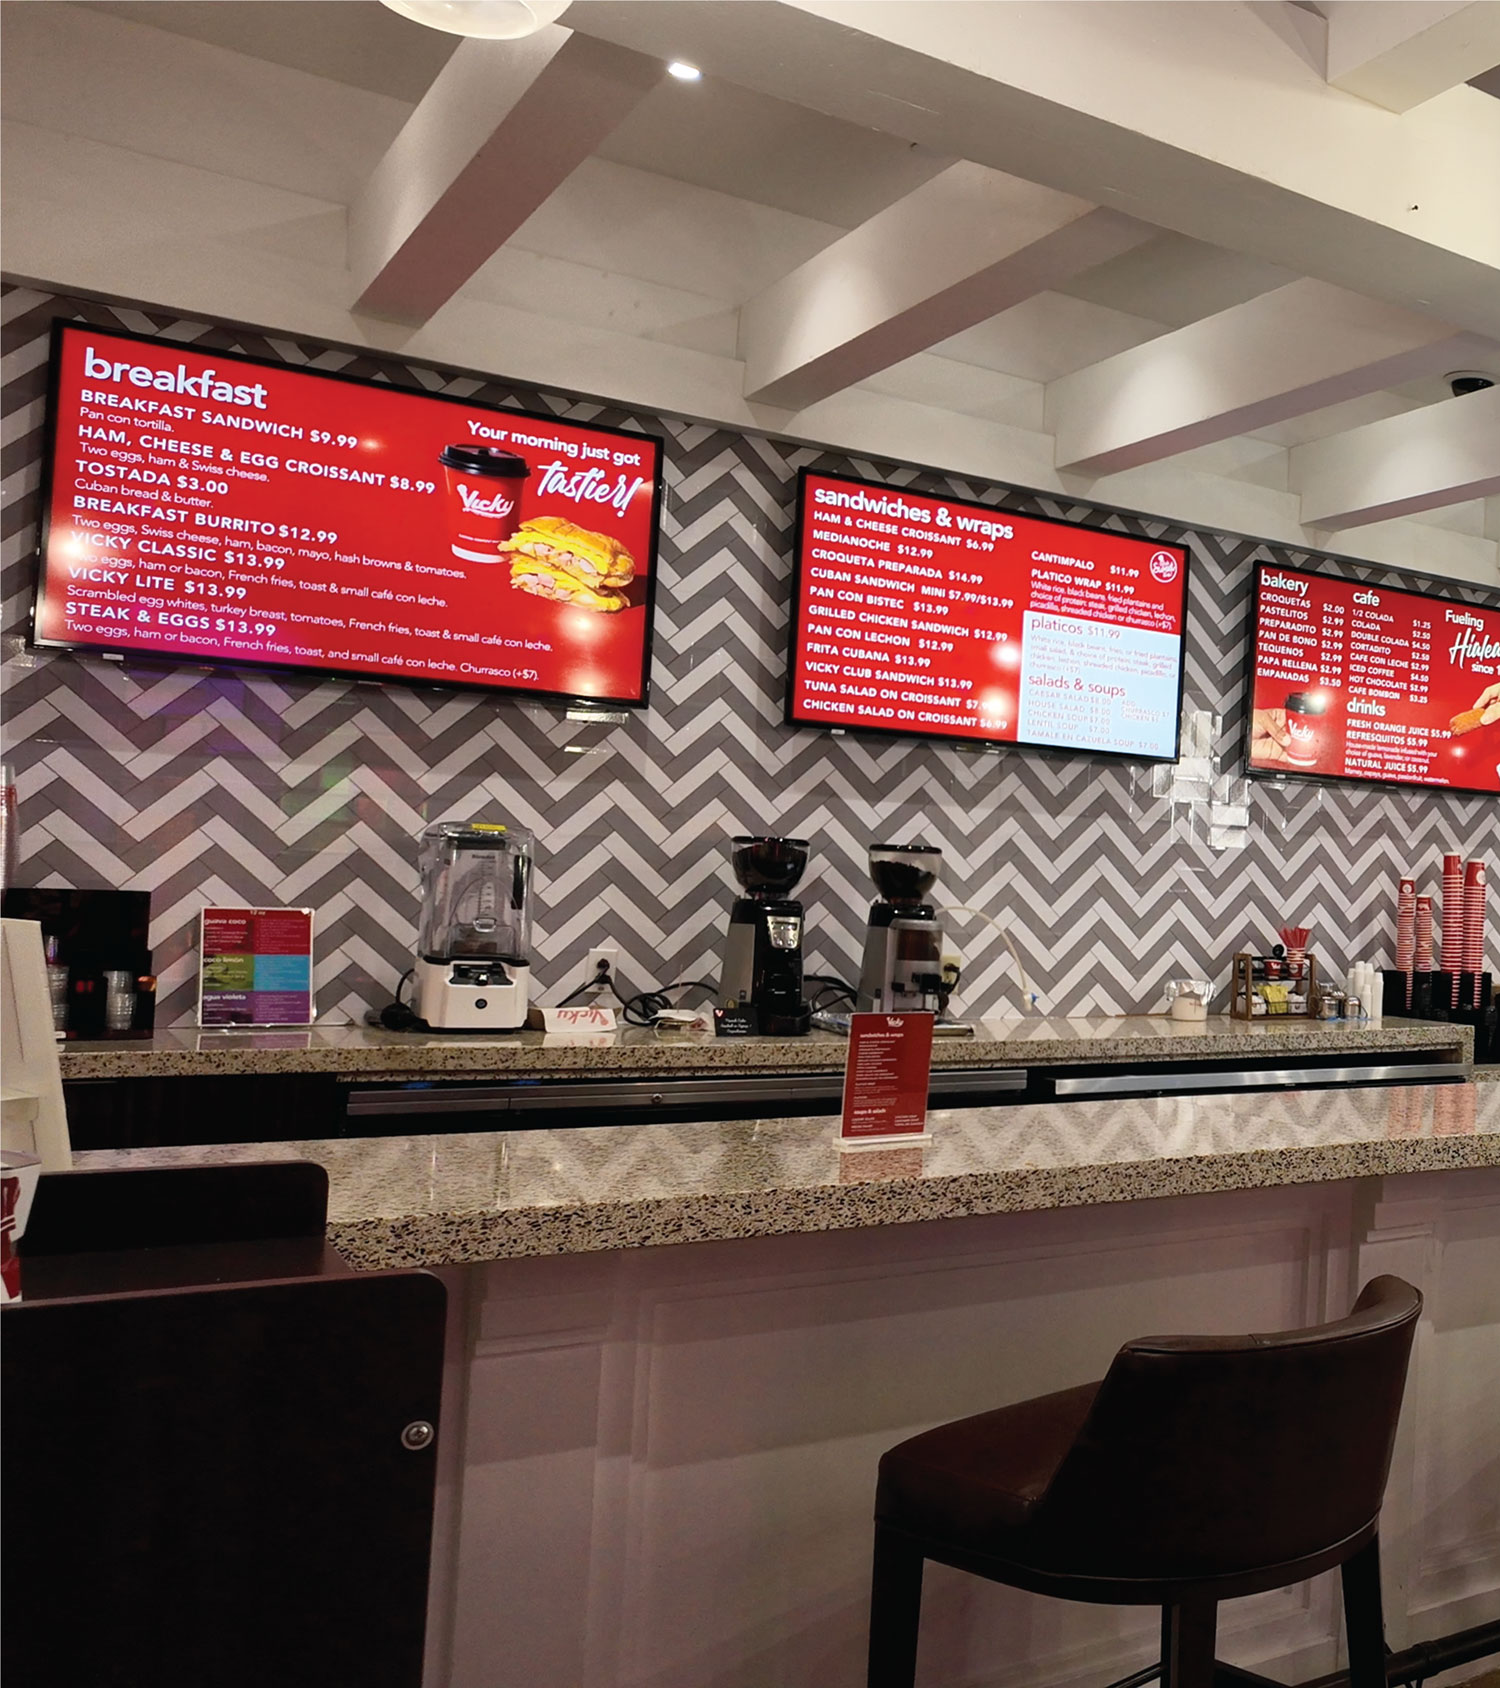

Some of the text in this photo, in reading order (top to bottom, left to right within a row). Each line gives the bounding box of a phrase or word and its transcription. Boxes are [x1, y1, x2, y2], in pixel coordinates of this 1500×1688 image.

[85, 347, 267, 409] breakfast
[79, 406, 174, 432] Pan con tortilla.
[80, 389, 357, 448] BREAKFAST SANDWICH $9.99
[467, 420, 640, 466] Your morning just got
[78, 424, 435, 494] HAM, CHEESE & EGG CROISSANT $8.99
[79, 441, 269, 482] Two eggs, ham & Swiss cheese.
[75, 459, 228, 494] TOSTADA $3.00
[74, 477, 213, 508] Cuban bread & butter.
[456, 483, 514, 518] Vicky
[73, 495, 337, 544] BREAKFAST BURRITO $12.99
[814, 488, 1013, 541] sandwiches & wraps
[812, 528, 933, 558] MEDIANOCHE $12.99
[813, 510, 994, 552] HAM & CHEESE CROISSANT $6.99
[70, 530, 284, 570] VICKY CLASSIC $13.99
[811, 547, 983, 584] CROQUETA PREPARADA $14.99
[1031, 550, 1094, 570] CANTIMPALO
[1110, 564, 1139, 578] $11.99
[67, 564, 246, 599] VICKY LITE $13.99
[810, 566, 1013, 608] CUBAN SANDWICH MINI $7.99/$13.99
[1031, 568, 1134, 594] PLATICO WRAP $11.99
[1260, 568, 1309, 597] bakery
[809, 585, 948, 615] PAN CON BISTEC $13.99
[1260, 591, 1344, 614] CROQUETAS $2.00
[1352, 589, 1380, 606] cafe
[65, 601, 276, 636] STEAK & EGGS $13.99
[808, 604, 1007, 641] GRILLED CHICKEN SANDWICH $12.99
[1031, 616, 1082, 634] platicos
[1259, 604, 1344, 626] PASTELITOS $2.99
[1259, 616, 1343, 638] PREPARADITO $2.99
[1352, 608, 1430, 629] 1/2 COLADA $1.25
[1445, 609, 1484, 631] Fueling
[807, 623, 953, 652] PAN CON LECHON $12.99
[1258, 629, 1343, 650] PAN DE BONO $2.99
[1350, 619, 1430, 639] COLADA $2.50
[806, 642, 930, 667] FRITA CUBANA $13.99
[1257, 654, 1342, 674] PAPA RELLENA $2.99
[1258, 642, 1342, 662] TEQUENOS $2.99
[1349, 652, 1429, 671] CAFE CON LECHE $2.99
[1350, 641, 1429, 661] CORTADITO $2.50
[804, 660, 972, 690] VICKY CLUB SANDWICH $13.99
[1257, 667, 1341, 687] EMPANADAS $3.50
[1471, 661, 1494, 674] since
[1028, 673, 1125, 698] salads & soups
[802, 698, 854, 713] CHICKEN
[857, 704, 895, 718] SALAD
[897, 709, 915, 720] ON
[918, 712, 976, 725] CROISSANT
[1346, 696, 1386, 716] drinks
[1346, 718, 1451, 738] FRESH ORANGE JUICE $5.99
[1346, 730, 1428, 747] REFRESQUITOS $5.99
[1344, 757, 1428, 773] NATURAL JUICE $5.99
